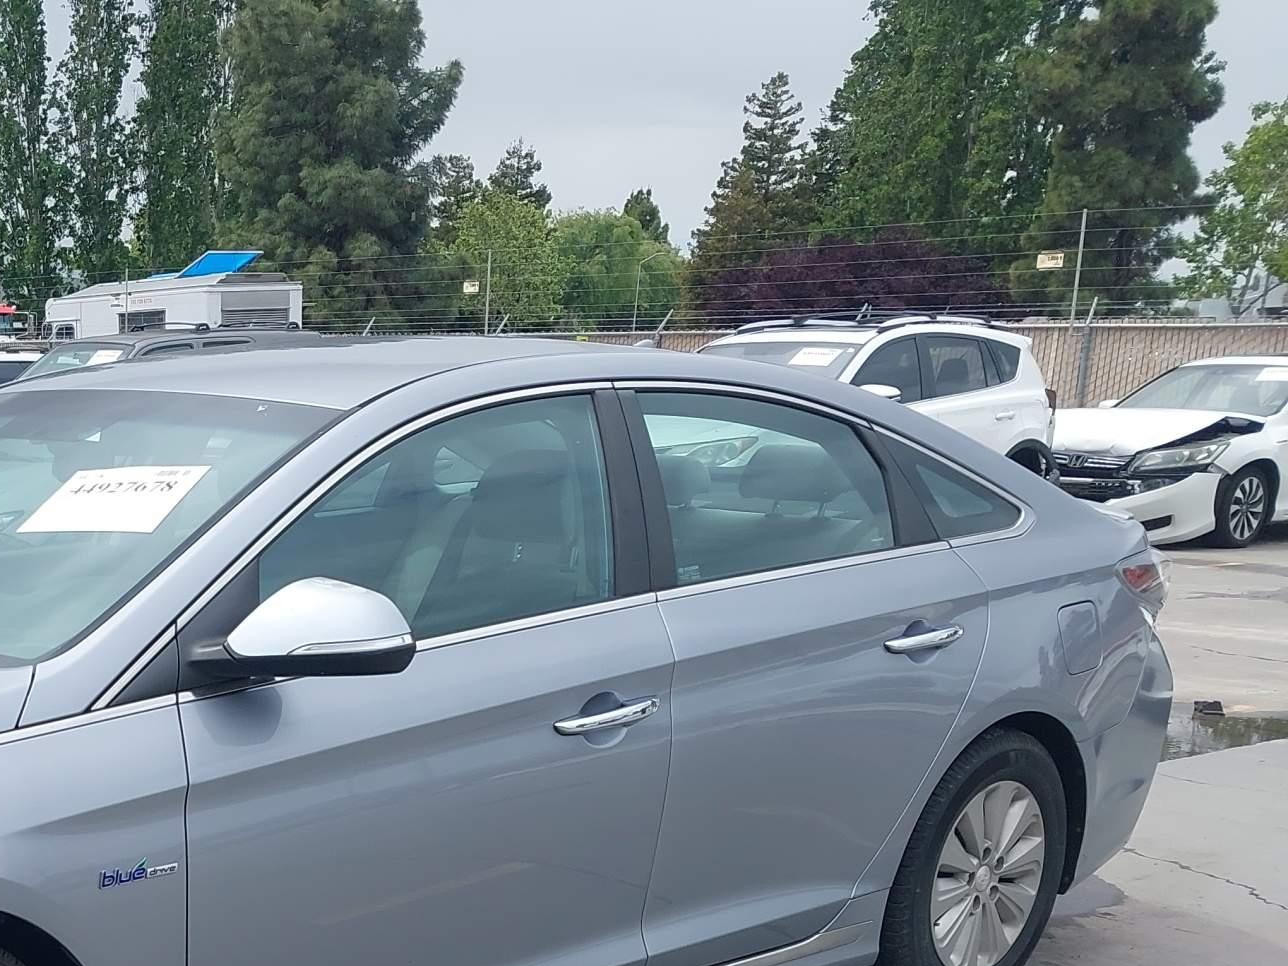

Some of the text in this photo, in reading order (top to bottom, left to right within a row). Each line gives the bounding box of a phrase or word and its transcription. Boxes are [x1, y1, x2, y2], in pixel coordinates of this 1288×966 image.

[70, 480, 180, 495] 44927678
[99, 865, 177, 889] blue drive
